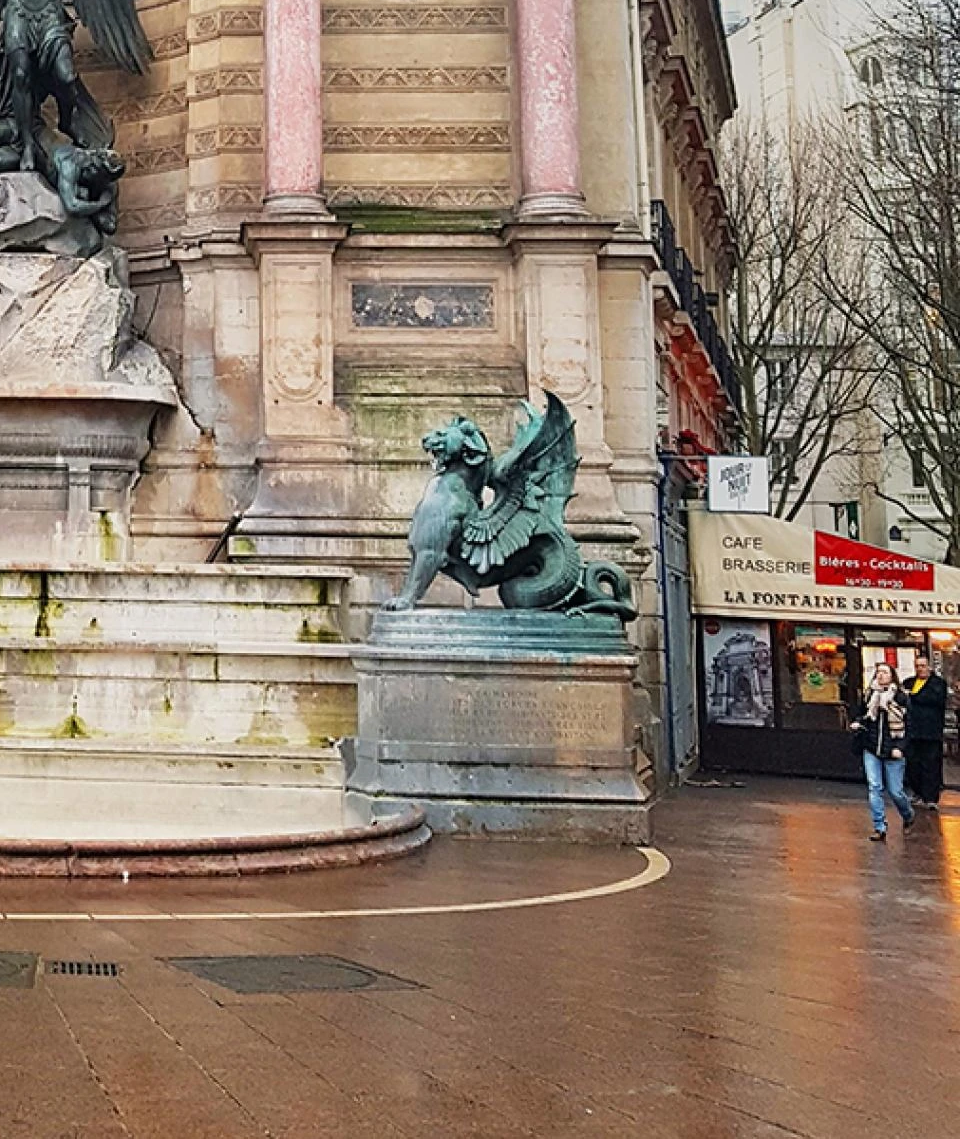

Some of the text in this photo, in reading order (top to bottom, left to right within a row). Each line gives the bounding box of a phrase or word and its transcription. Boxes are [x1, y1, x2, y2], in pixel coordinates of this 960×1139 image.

[722, 536, 763, 551] CAFE
[722, 557, 811, 575] BRASSERIE
[869, 557, 929, 572] Cocktails
[723, 590, 960, 615] LA FONTAINE SAINT MIC
